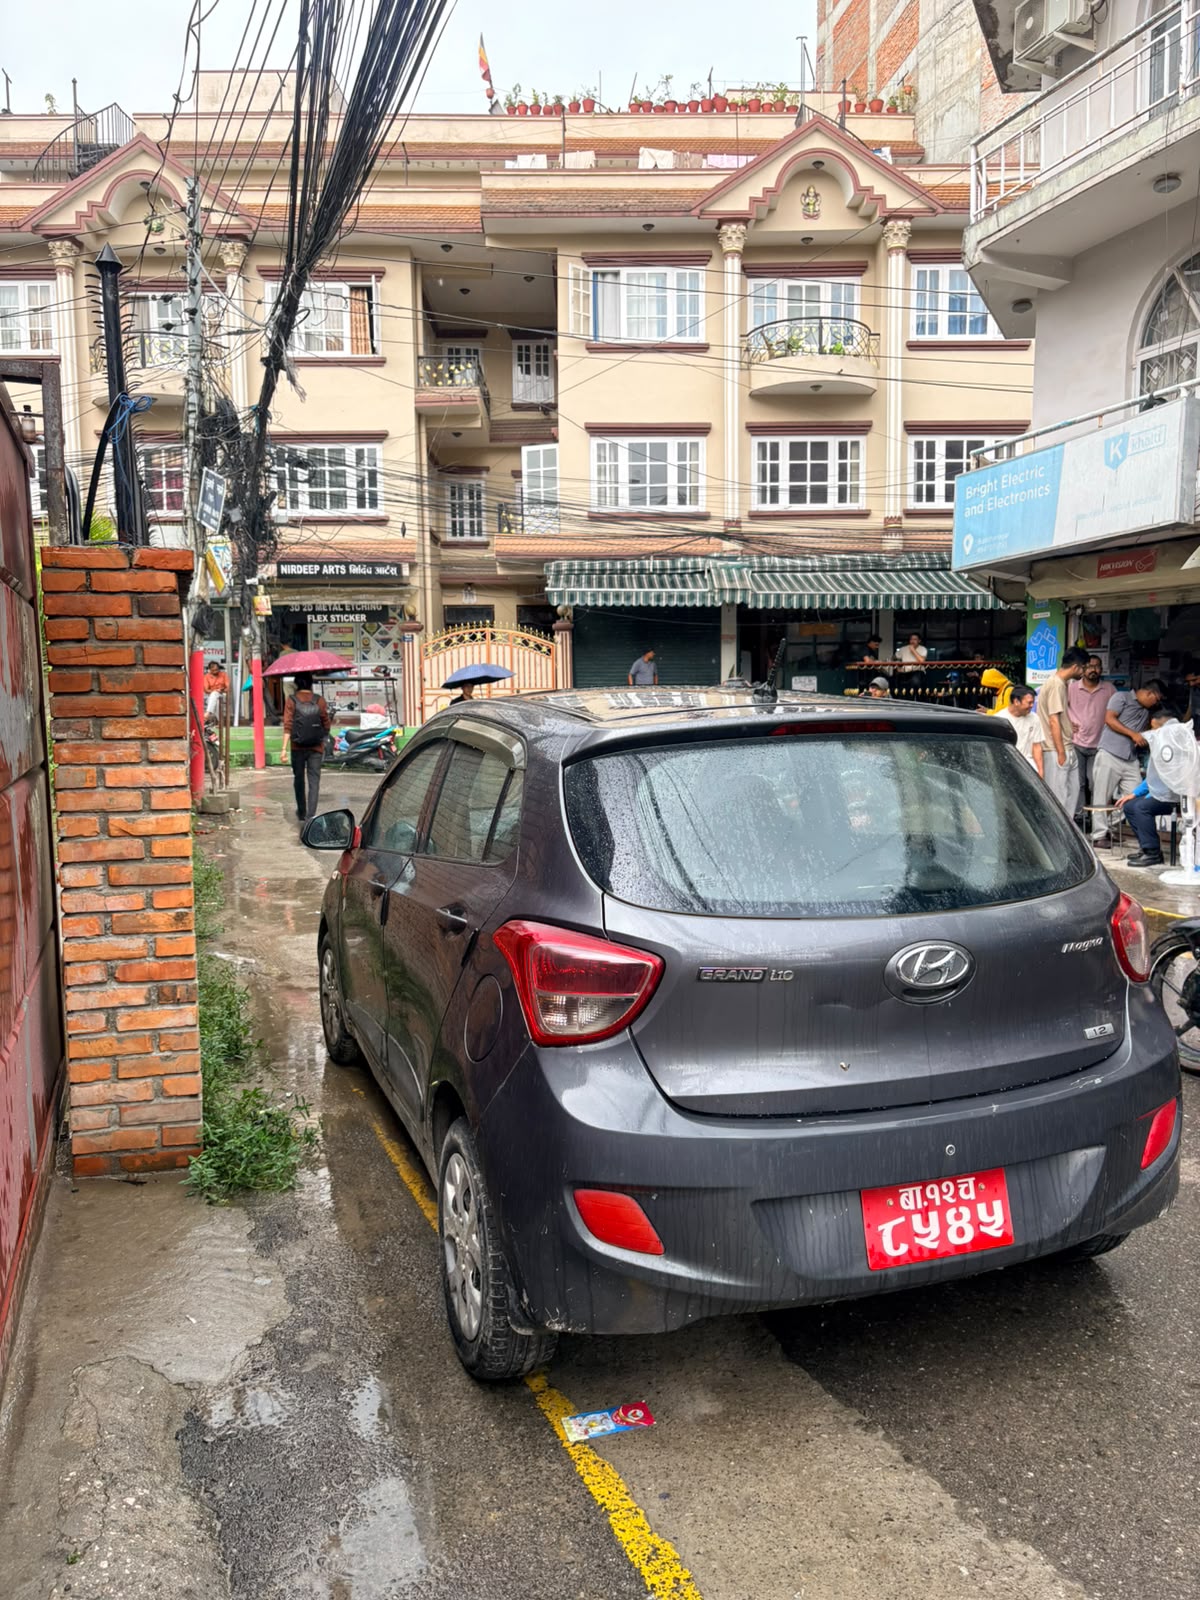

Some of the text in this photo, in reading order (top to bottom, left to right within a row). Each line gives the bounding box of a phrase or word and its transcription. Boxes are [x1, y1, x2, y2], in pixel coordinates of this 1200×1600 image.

[966, 464, 1045, 500] Bright Electric
[964, 501, 984, 518] and
[987, 483, 1051, 512] Electronics
[280, 564, 346, 575] NIRDEEP ARTS
[1100, 560, 1134, 571] HIKVISION
[315, 602, 343, 611] METAL
[345, 602, 382, 611] ETCHING
[307, 614, 367, 622] FLEX STICKER
[701, 969, 764, 981] GRAND
[877, 1199, 1005, 1257] ८५४५
